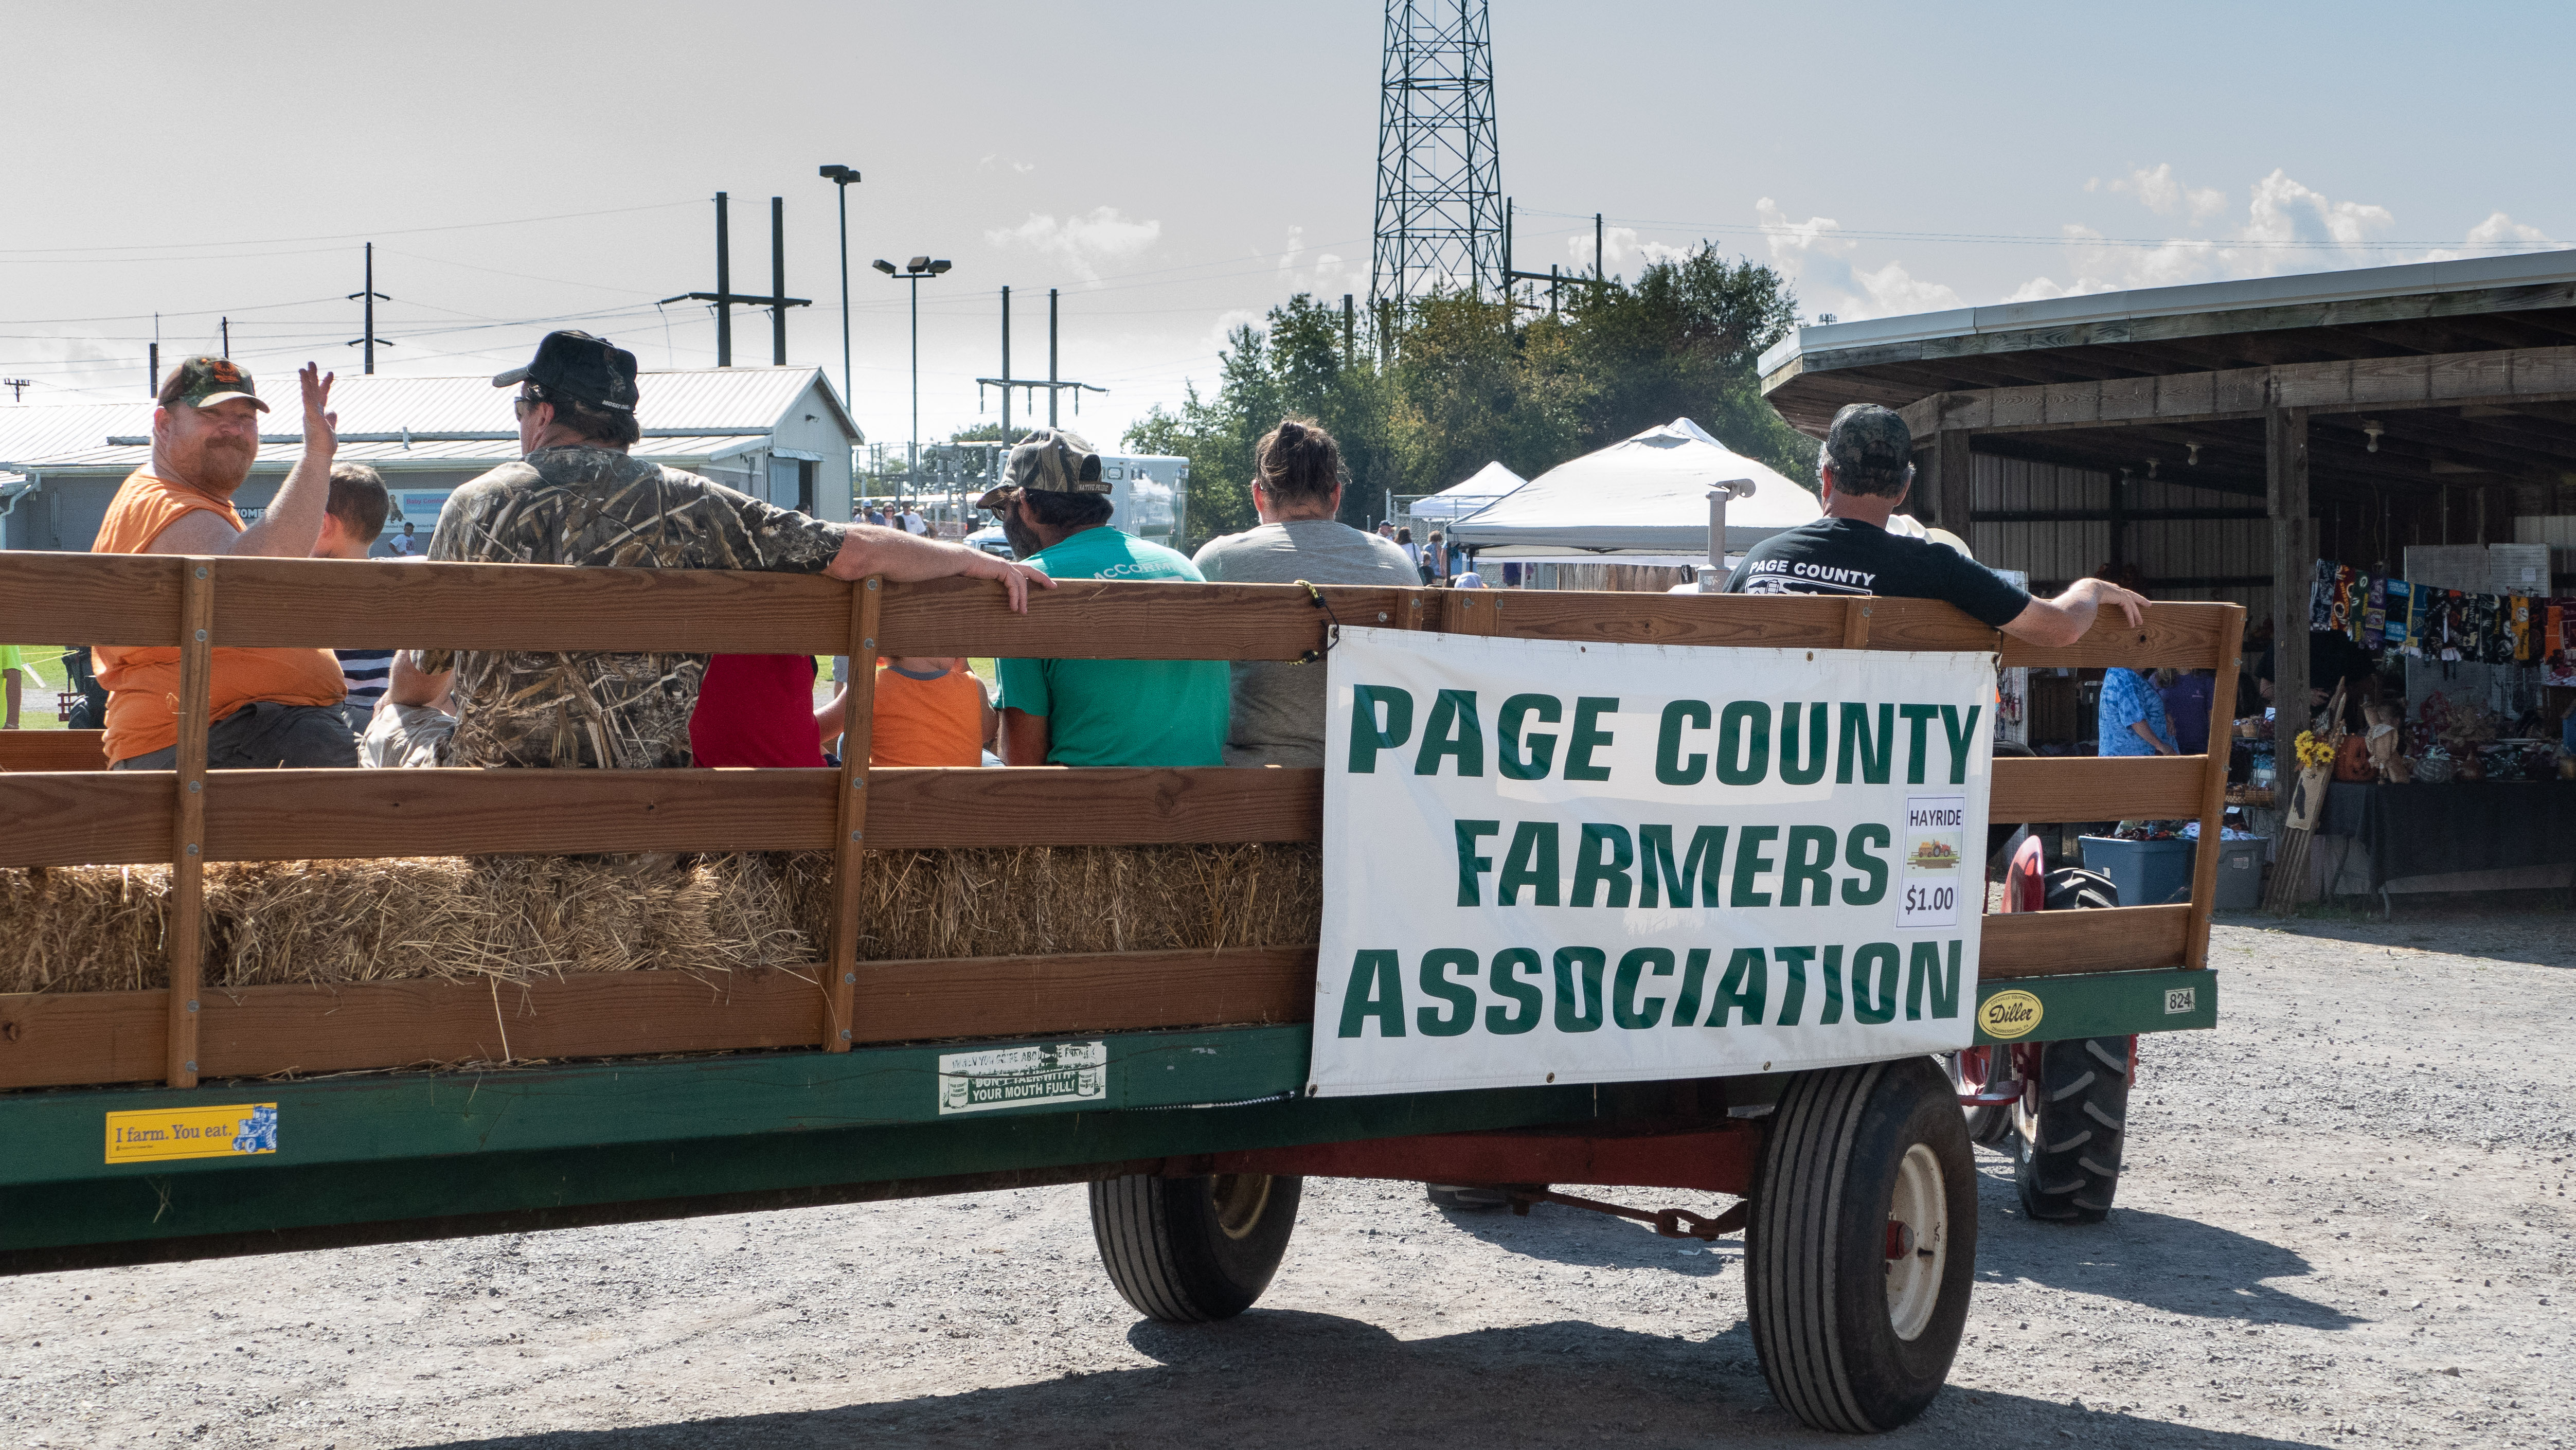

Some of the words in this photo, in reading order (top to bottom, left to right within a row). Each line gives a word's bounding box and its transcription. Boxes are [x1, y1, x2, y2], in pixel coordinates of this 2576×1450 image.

[1749, 560, 1789, 575] PAGE
[1794, 563, 1876, 586] COUNTY
[1349, 685, 1619, 781] PAGE
[1656, 700, 1981, 785] COUNTY
[1910, 810, 1961, 826] HAYRIDE
[1455, 820, 1890, 908] FARMERS
[1905, 885, 1954, 915] $1.00
[1338, 940, 1962, 1037] ASSOCIATION
[2170, 991, 2190, 1009] 824
[1989, 1002, 2033, 1024] Diller
[973, 1088, 1002, 1101] YOUR
[1005, 1082, 1043, 1098] MOUTH
[1046, 1079, 1075, 1095] FULL!
[116, 1128, 122, 1143] I
[127, 1126, 169, 1142] farm.
[171, 1124, 201, 1140] You
[205, 1124, 232, 1138] eat.
